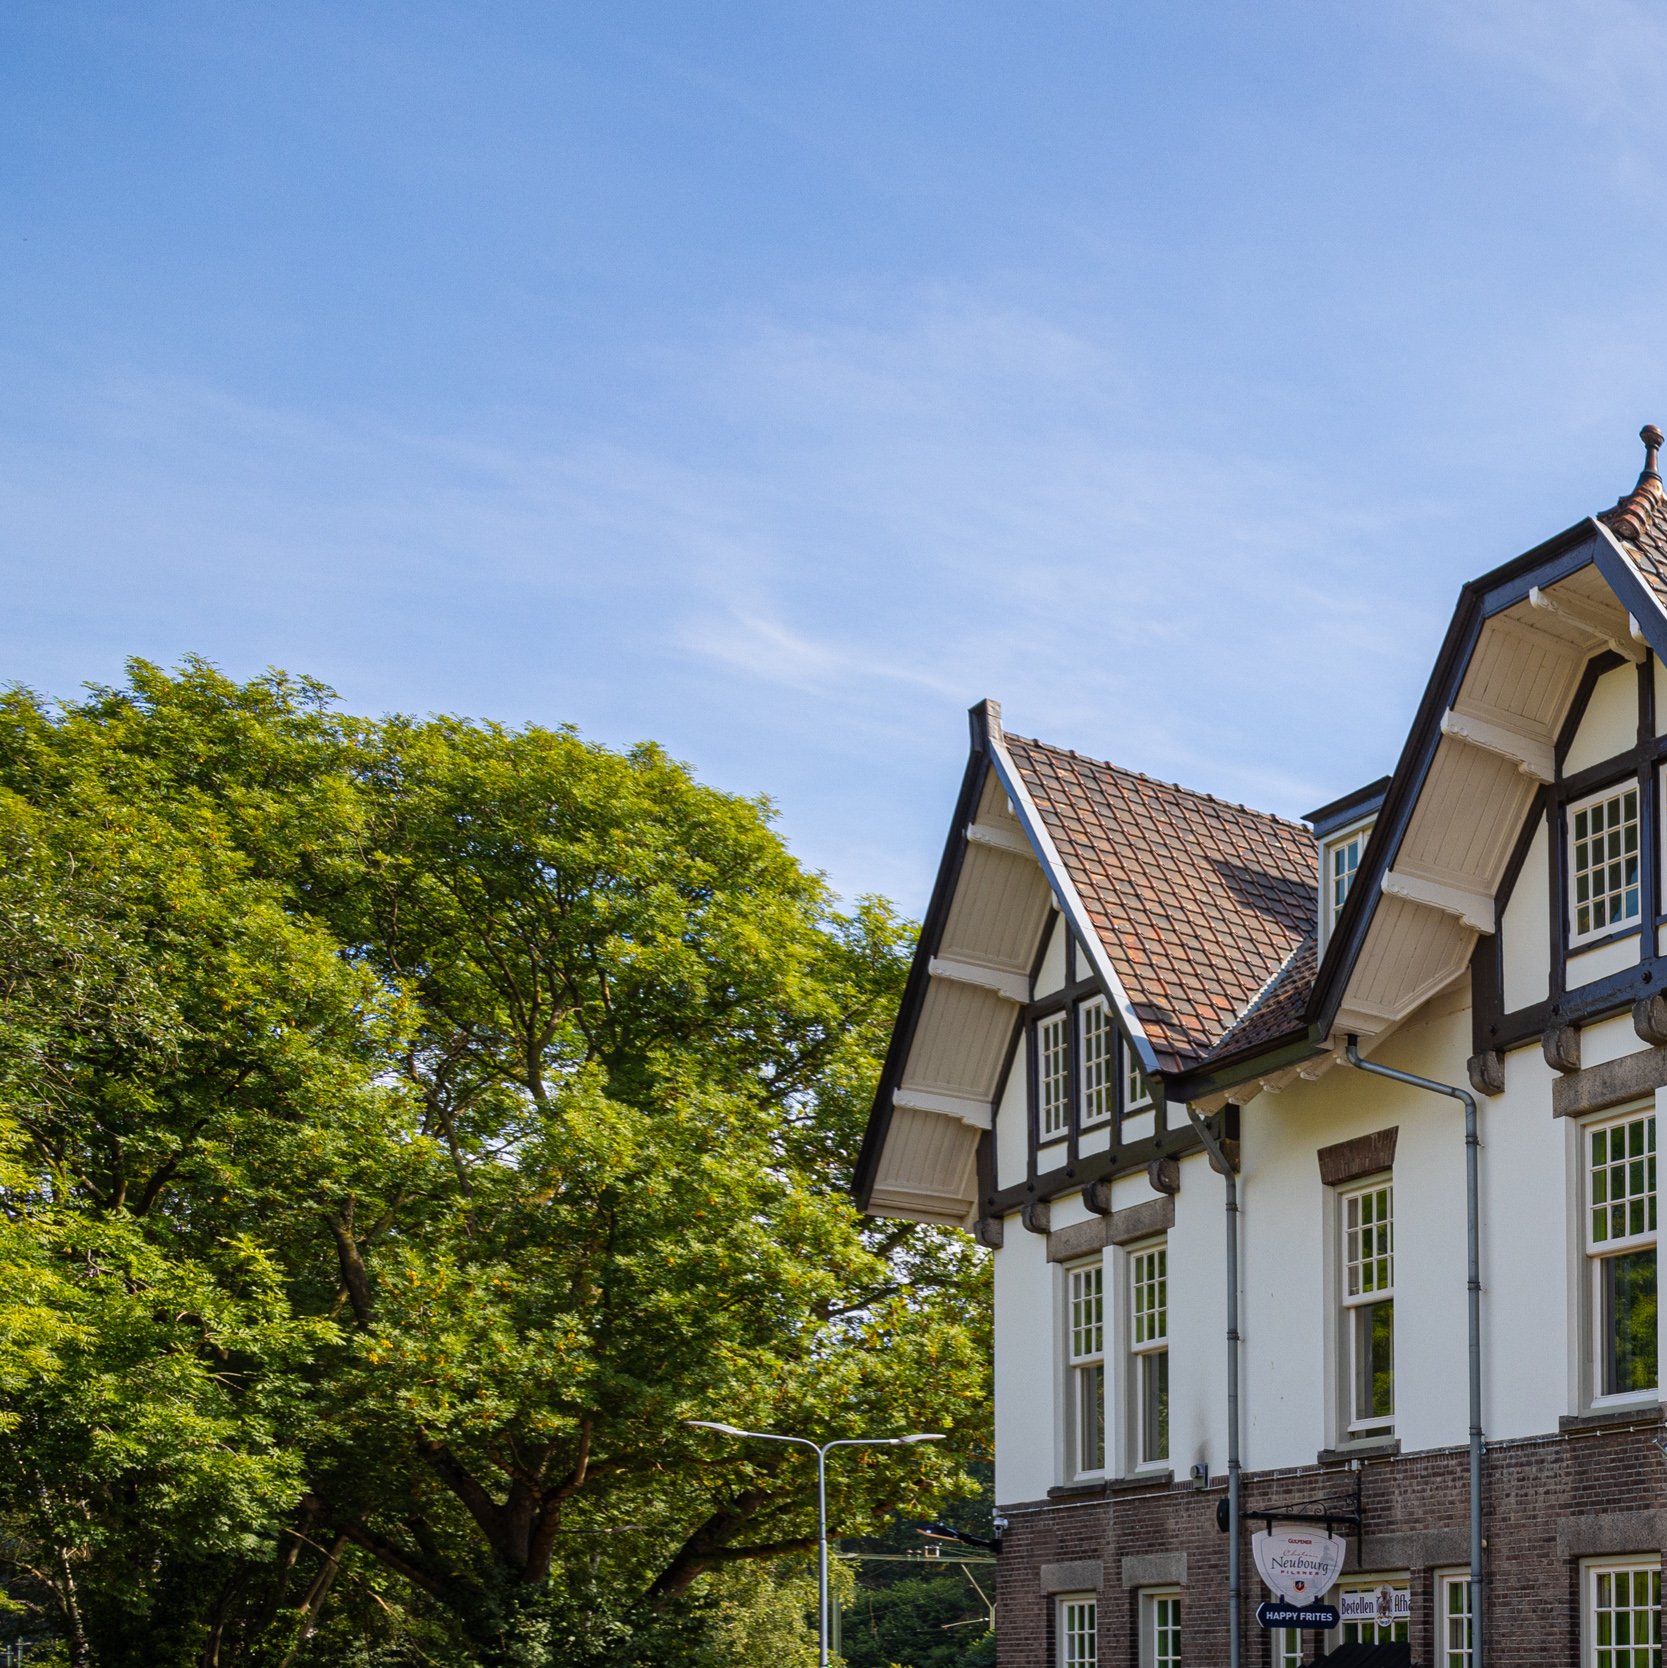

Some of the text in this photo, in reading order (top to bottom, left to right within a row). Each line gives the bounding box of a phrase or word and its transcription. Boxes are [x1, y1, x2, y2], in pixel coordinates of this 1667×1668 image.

[1270, 1556, 1329, 1576] Neubourg
[1341, 1597, 1374, 1615] Bestellen
[1266, 1611, 1333, 1622] HAPPY FRITES
